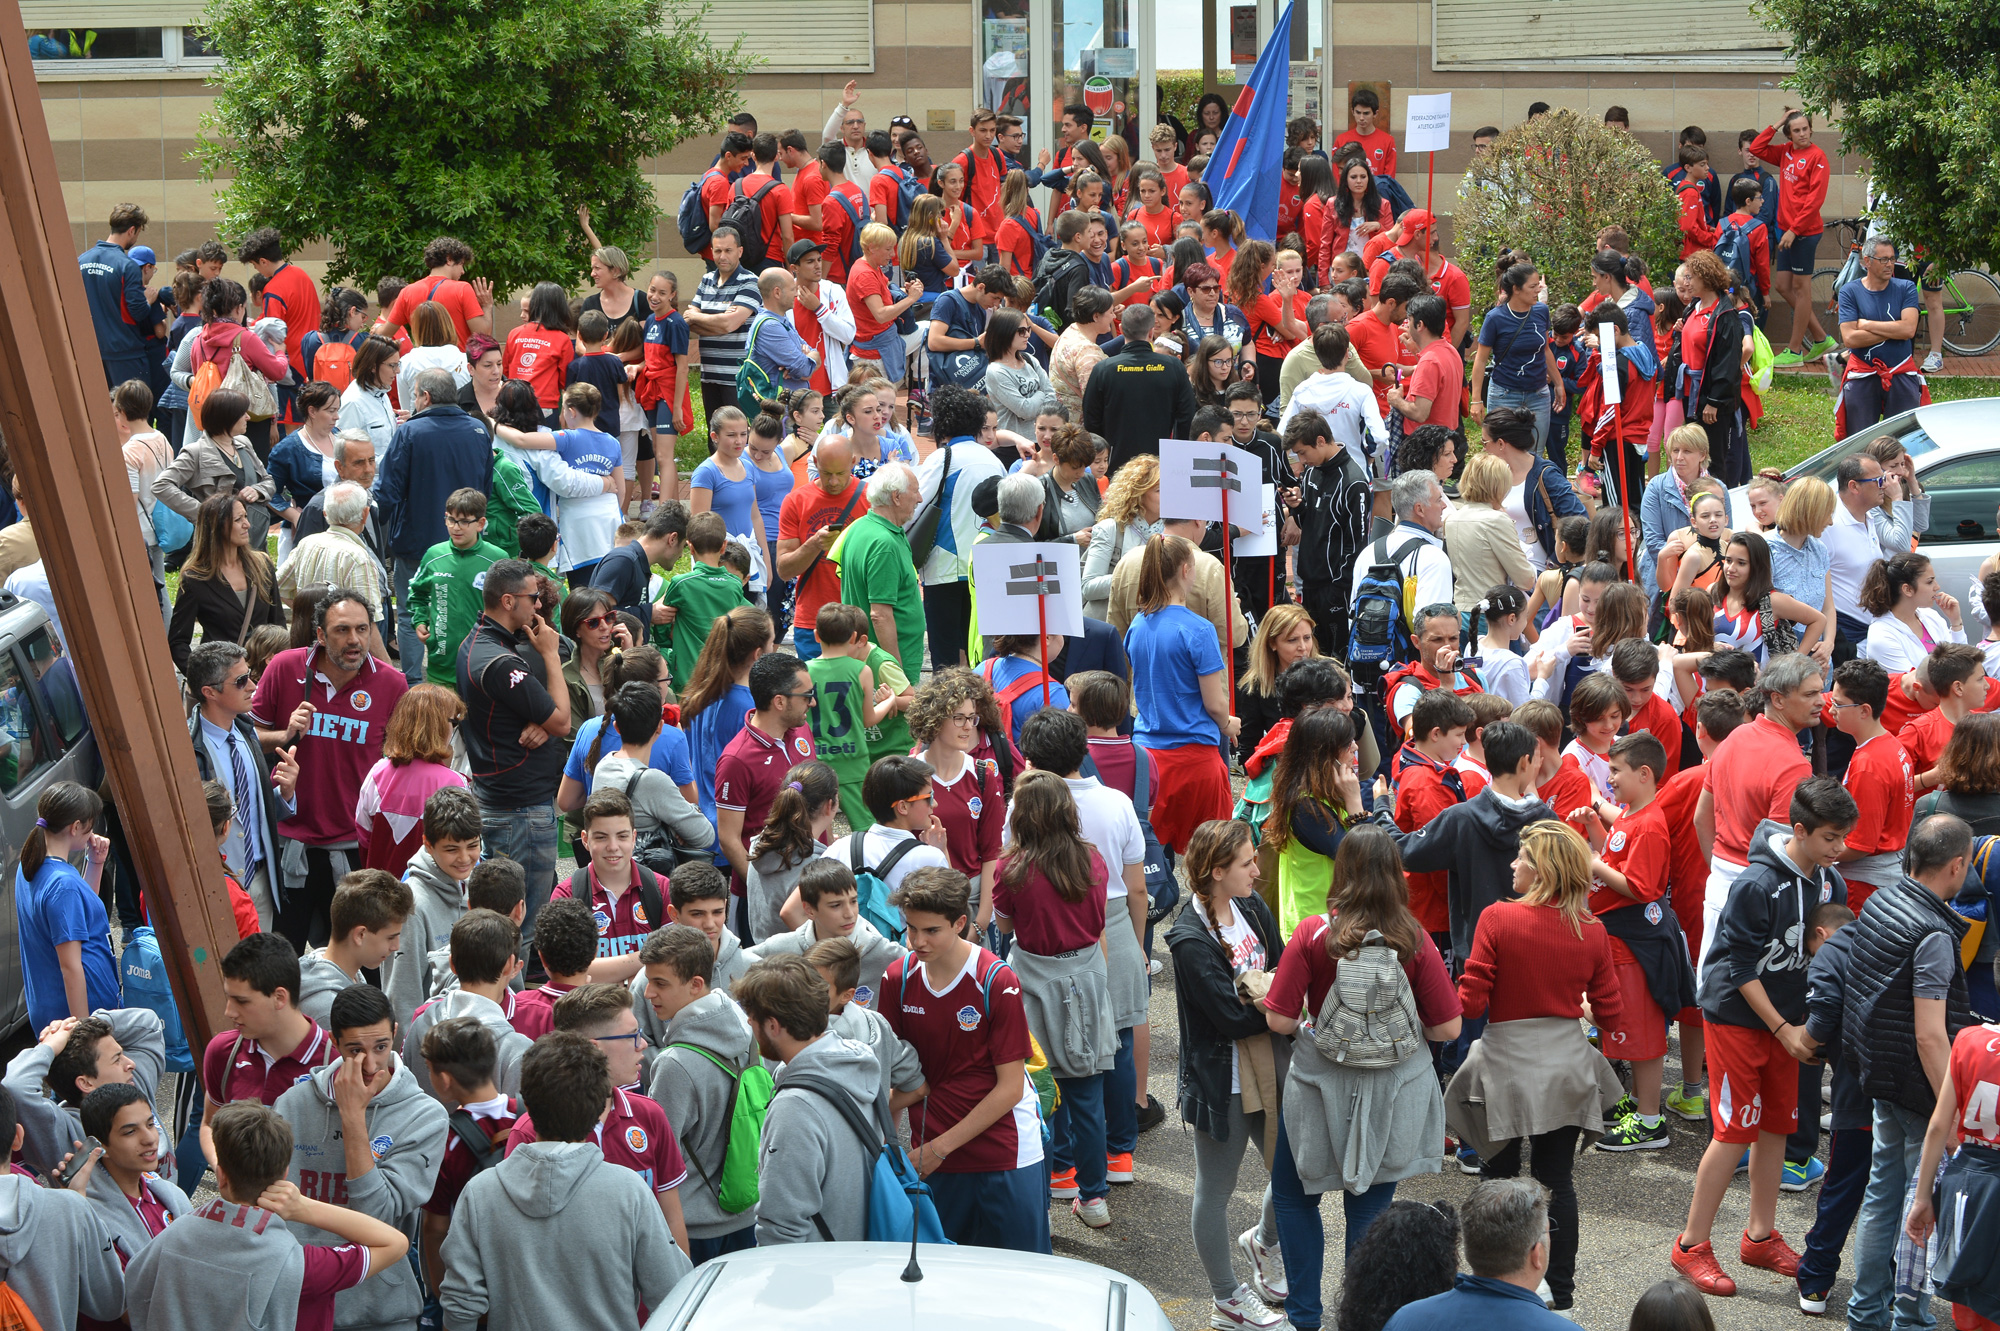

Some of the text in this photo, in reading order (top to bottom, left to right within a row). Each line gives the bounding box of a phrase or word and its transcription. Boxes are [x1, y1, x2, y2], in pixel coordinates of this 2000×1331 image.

[79, 262, 114, 274] STUDENTESCA
[514, 338, 551, 348] STUDENTESCA
[1117, 363, 1165, 372] Fiamme Gialle
[810, 682, 853, 738] 13
[306, 712, 370, 744] IETI
[721, 781, 730, 801] Joma
[126, 964, 153, 980] Joma
[902, 1004, 926, 1015] Joma
[299, 1168, 349, 1205] RIE
